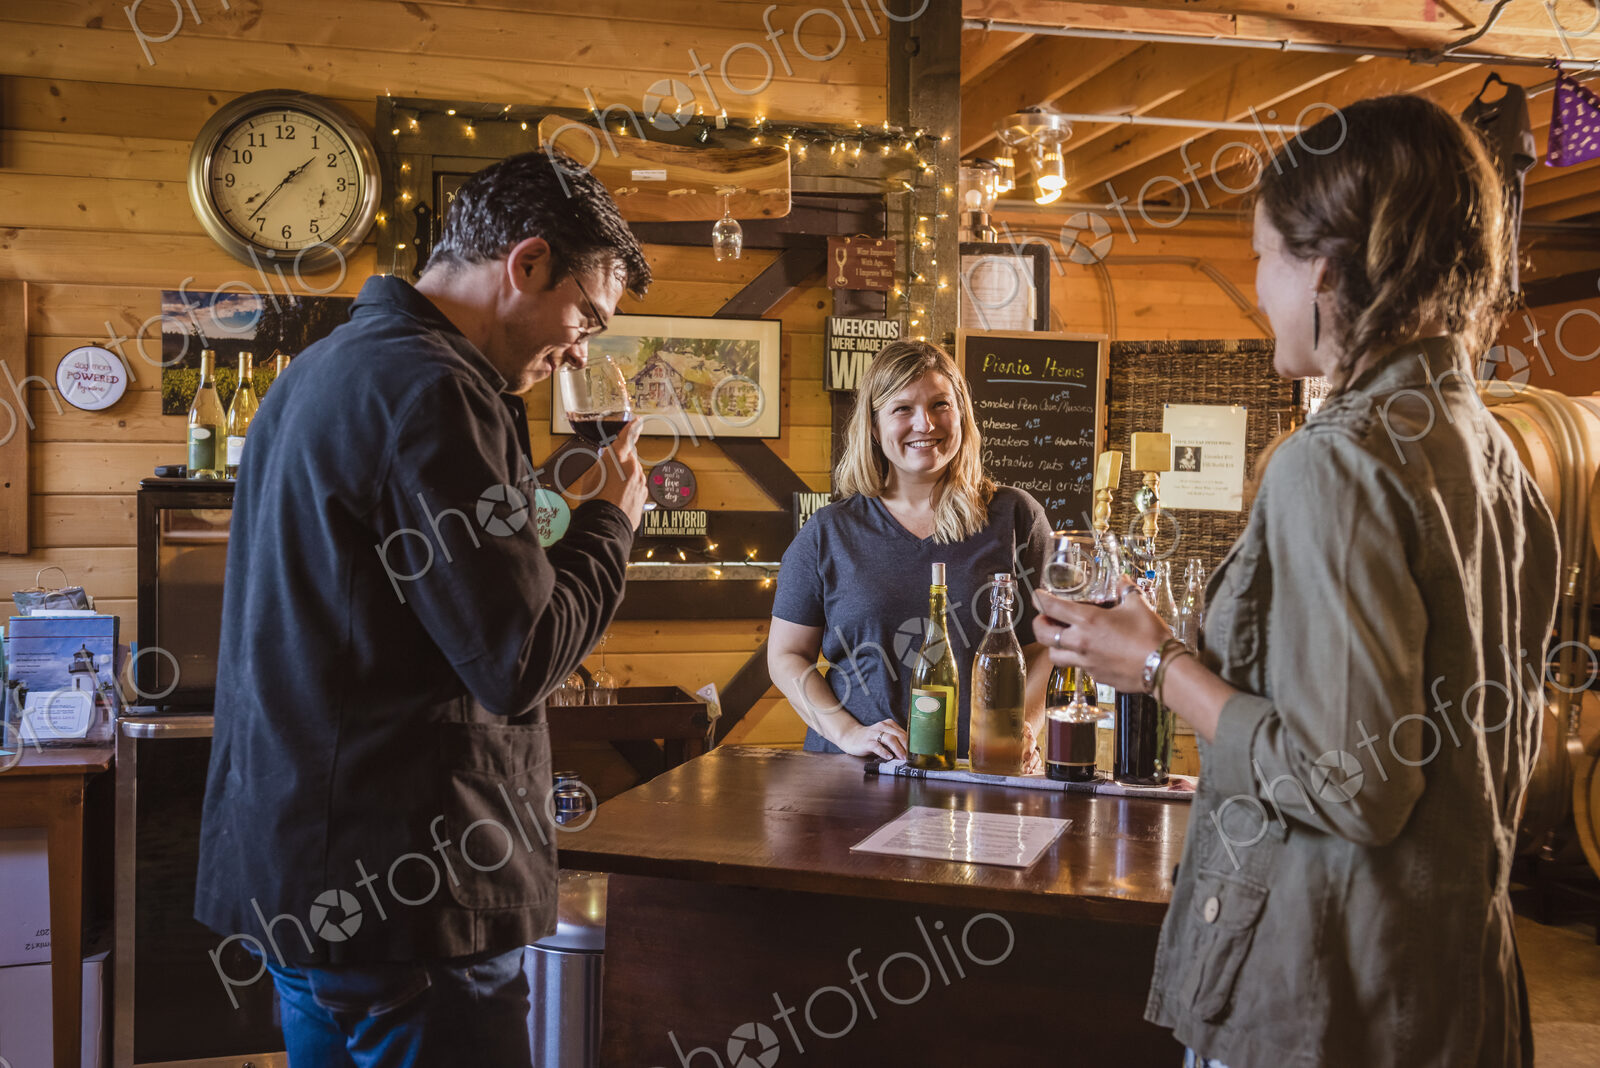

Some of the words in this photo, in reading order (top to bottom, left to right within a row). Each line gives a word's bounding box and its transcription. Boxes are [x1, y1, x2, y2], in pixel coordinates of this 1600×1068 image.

[247, 132, 268, 148] 11
[275, 125, 296, 140] 12
[311, 135, 320, 150] 1
[232, 150, 253, 164] 10
[327, 153, 337, 168] 2
[225, 173, 236, 188] 9
[336, 177, 347, 192] 3
[256, 217, 266, 232] 7
[309, 219, 320, 234] 5
[281, 225, 292, 240] 6
[832, 317, 899, 339] WEEKENDS
[831, 336, 855, 350] WERE
[856, 338, 880, 352] MADE
[982, 353, 1032, 376] Picnic
[1041, 356, 1084, 378] Items
[66, 371, 119, 384] POWERED
[982, 417, 1021, 430] cheese
[644, 510, 660, 528] I'M
[662, 510, 669, 528] A
[671, 510, 707, 528] HYBRID
